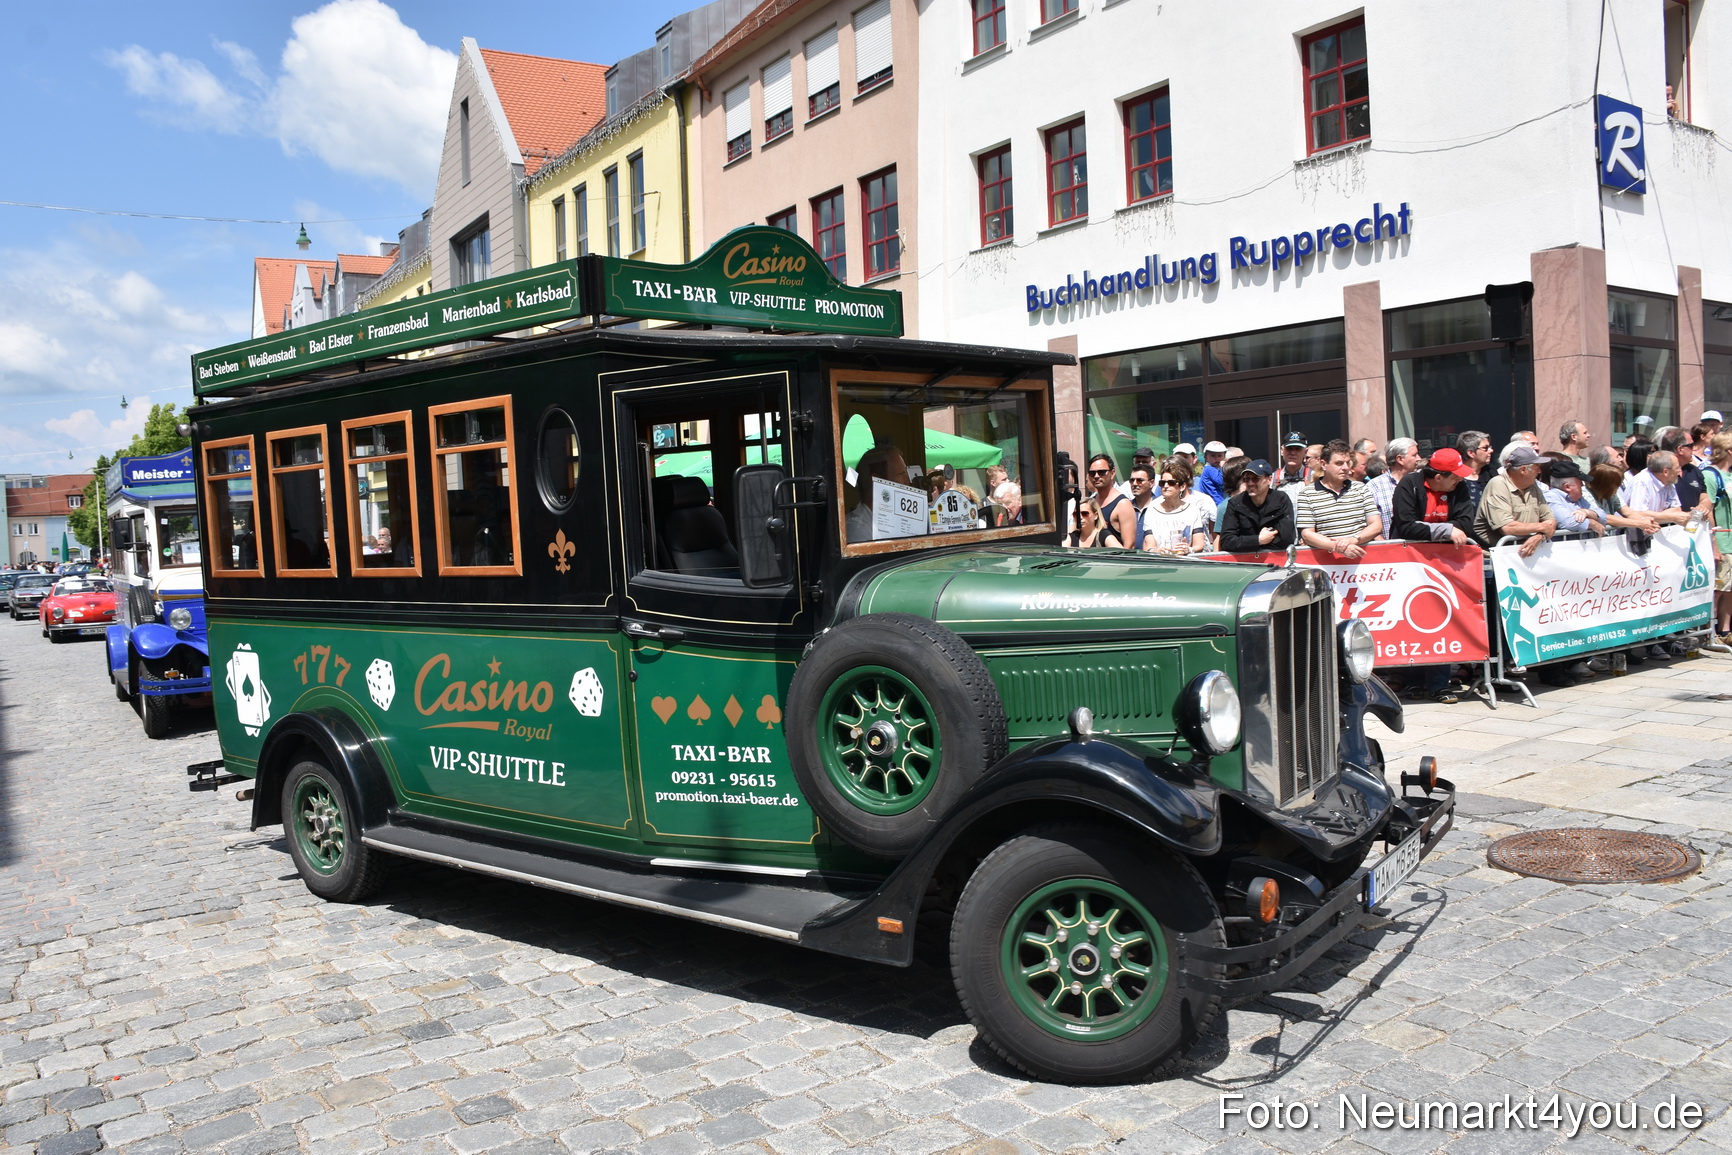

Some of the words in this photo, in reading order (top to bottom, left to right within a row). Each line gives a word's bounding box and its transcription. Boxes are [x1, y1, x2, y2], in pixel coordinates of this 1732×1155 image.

[723, 242, 806, 279] Casino
[1026, 250, 1219, 312] Buchhandlung
[1229, 202, 1413, 271] Rupprecht
[779, 276, 805, 287] Royal
[632, 279, 717, 304] TAXI-BÄR
[729, 290, 806, 311] VIP-SHUTTLE
[815, 299, 885, 319] PROMOTION
[199, 366, 213, 380] Bad
[214, 361, 239, 378] Steben
[247, 345, 297, 369] Weißenstadt
[309, 338, 327, 355] Bad
[328, 333, 354, 351] Elster
[367, 312, 429, 340] Franzensbad
[442, 297, 501, 325] Marienbad
[516, 280, 572, 309] Karlsbad
[900, 497, 918, 515] 628
[946, 495, 959, 512] 85
[1330, 567, 1397, 585] klassik
[1561, 575, 1600, 597] UNS
[1340, 587, 1392, 619] tz
[1606, 586, 1674, 613] BESSER
[1376, 637, 1463, 658] ietz.de
[1541, 638, 1585, 653] Service-Line:
[293, 644, 352, 688] 777
[414, 653, 554, 716] Casino
[503, 719, 553, 742] Royal
[671, 744, 772, 764] TAXI-BÄR
[429, 745, 566, 787] VIP-SHUTTLE
[671, 771, 716, 785] 09231
[730, 773, 777, 788] 95615
[655, 790, 799, 807] promotion.taxi-baer.de
